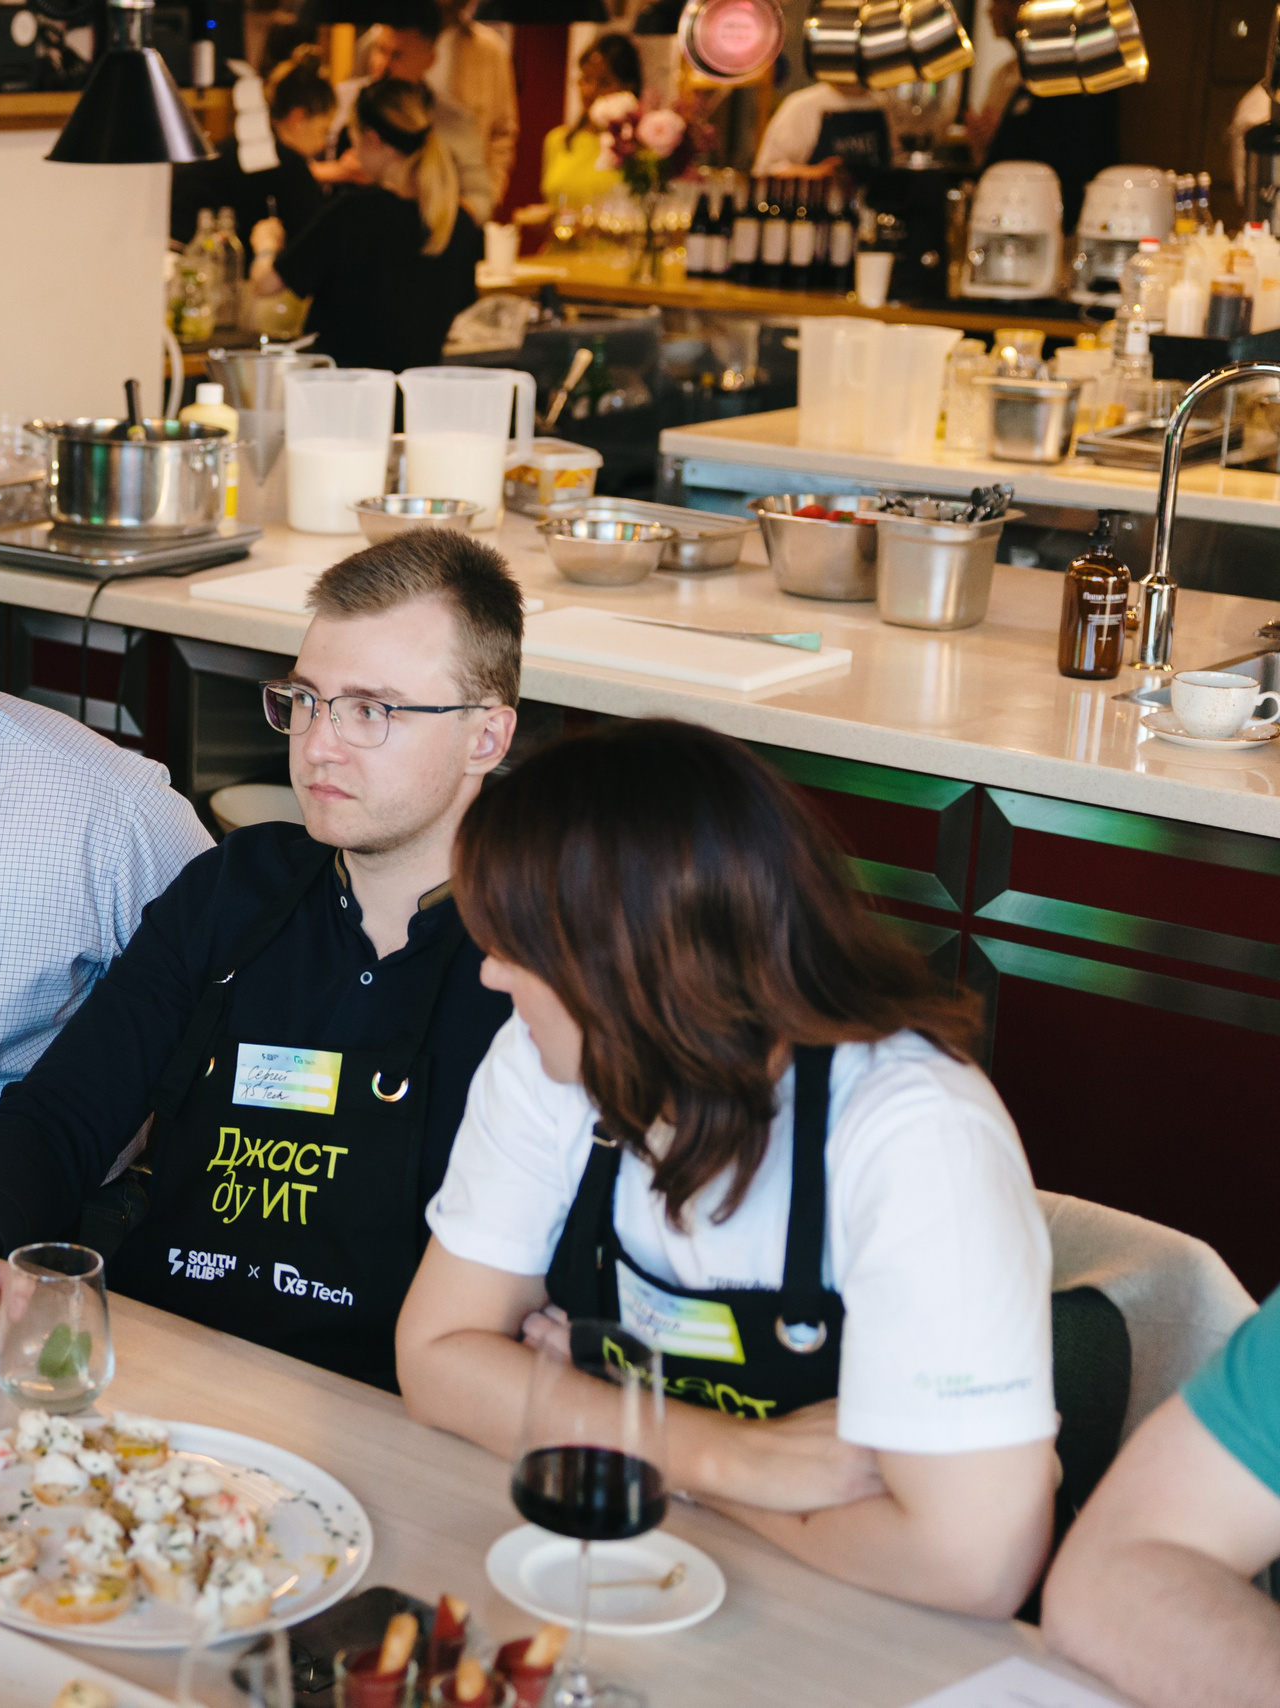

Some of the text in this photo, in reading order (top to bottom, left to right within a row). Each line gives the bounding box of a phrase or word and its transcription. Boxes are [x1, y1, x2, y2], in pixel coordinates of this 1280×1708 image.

[248, 1065, 293, 1085] Сергей
[206, 1127, 349, 1179] Джаст
[212, 1170, 318, 1225] ду ИТ
[187, 1250, 237, 1270] SOUTH
[310, 1280, 354, 1306] Tech
